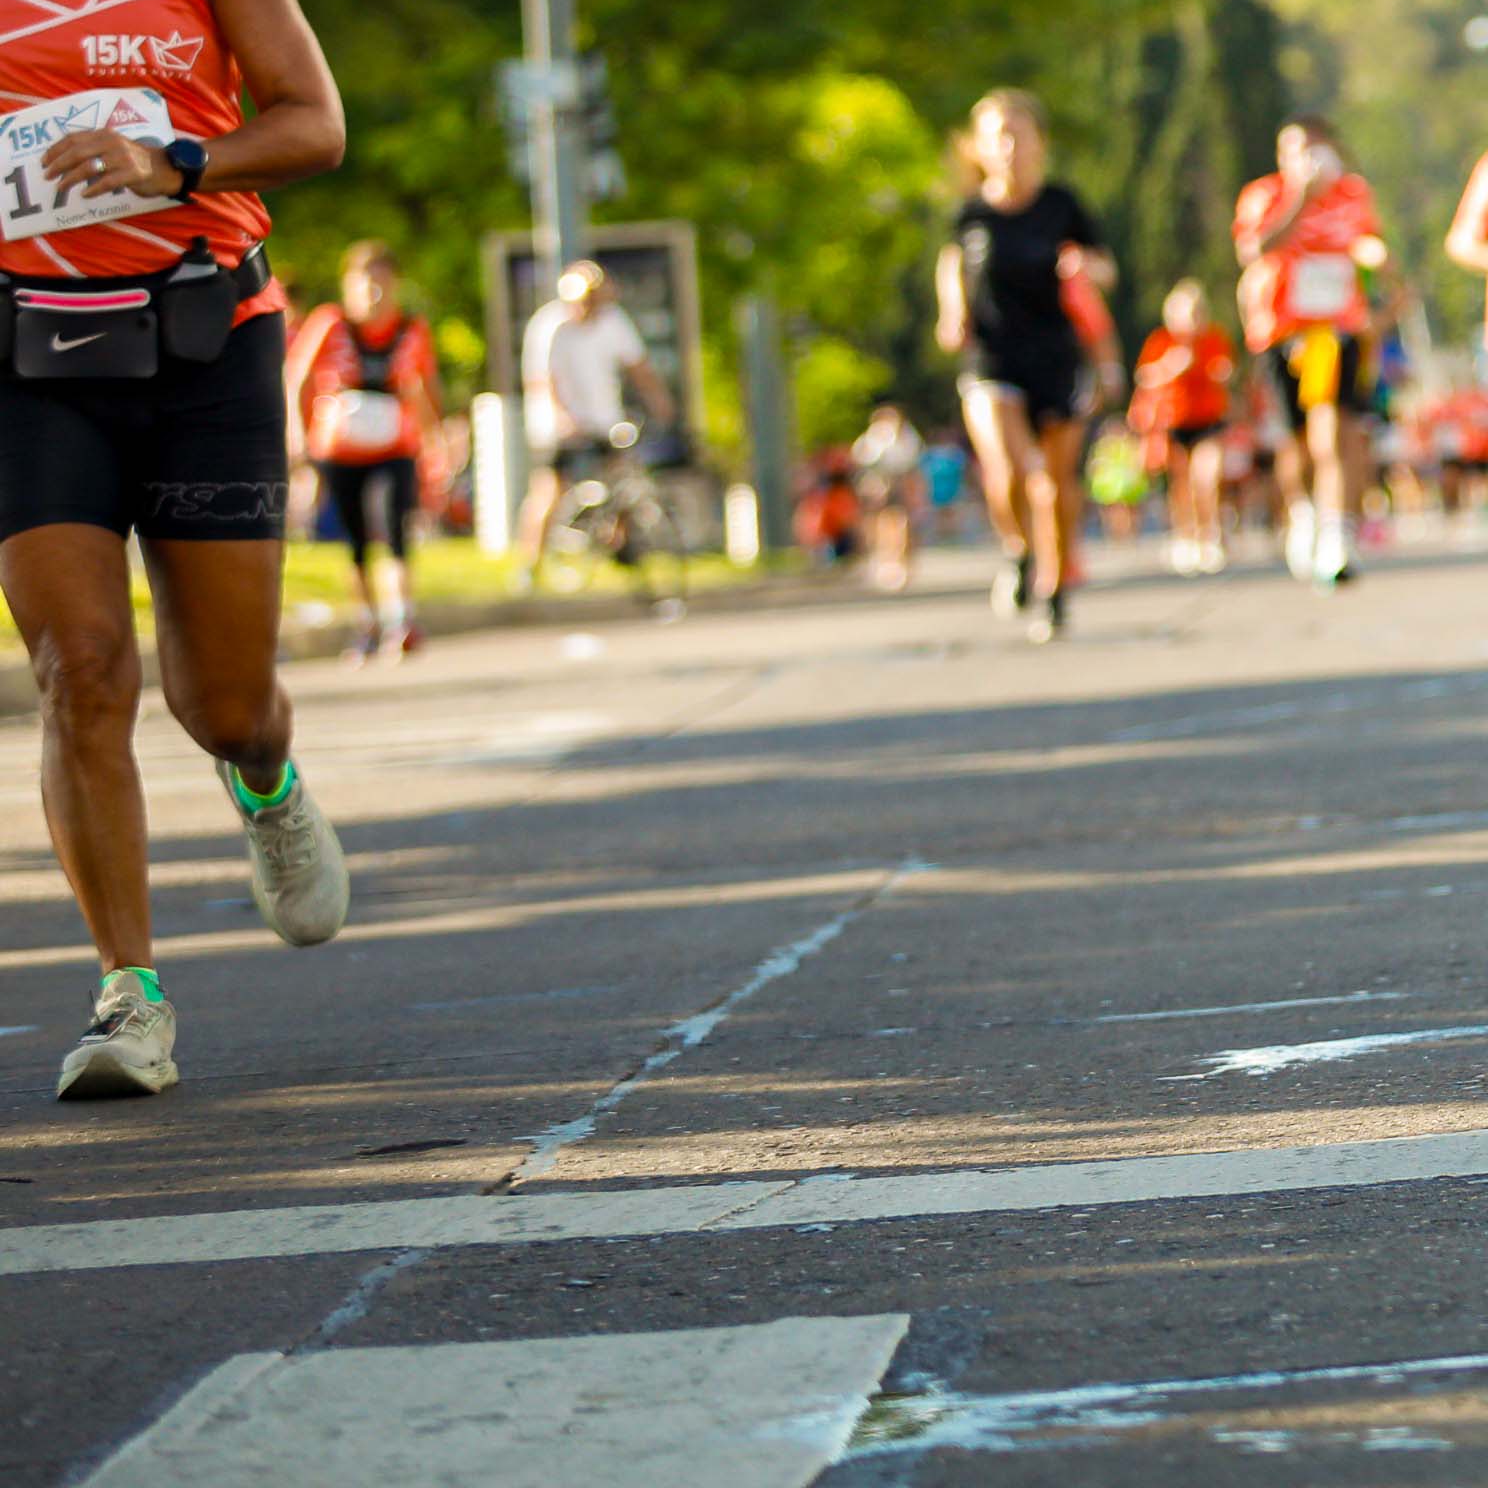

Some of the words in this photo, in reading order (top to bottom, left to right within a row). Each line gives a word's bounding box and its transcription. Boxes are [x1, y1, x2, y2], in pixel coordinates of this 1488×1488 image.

[81, 34, 147, 66] 15K
[112, 110, 140, 123] 15K
[8, 119, 53, 152] 15K
